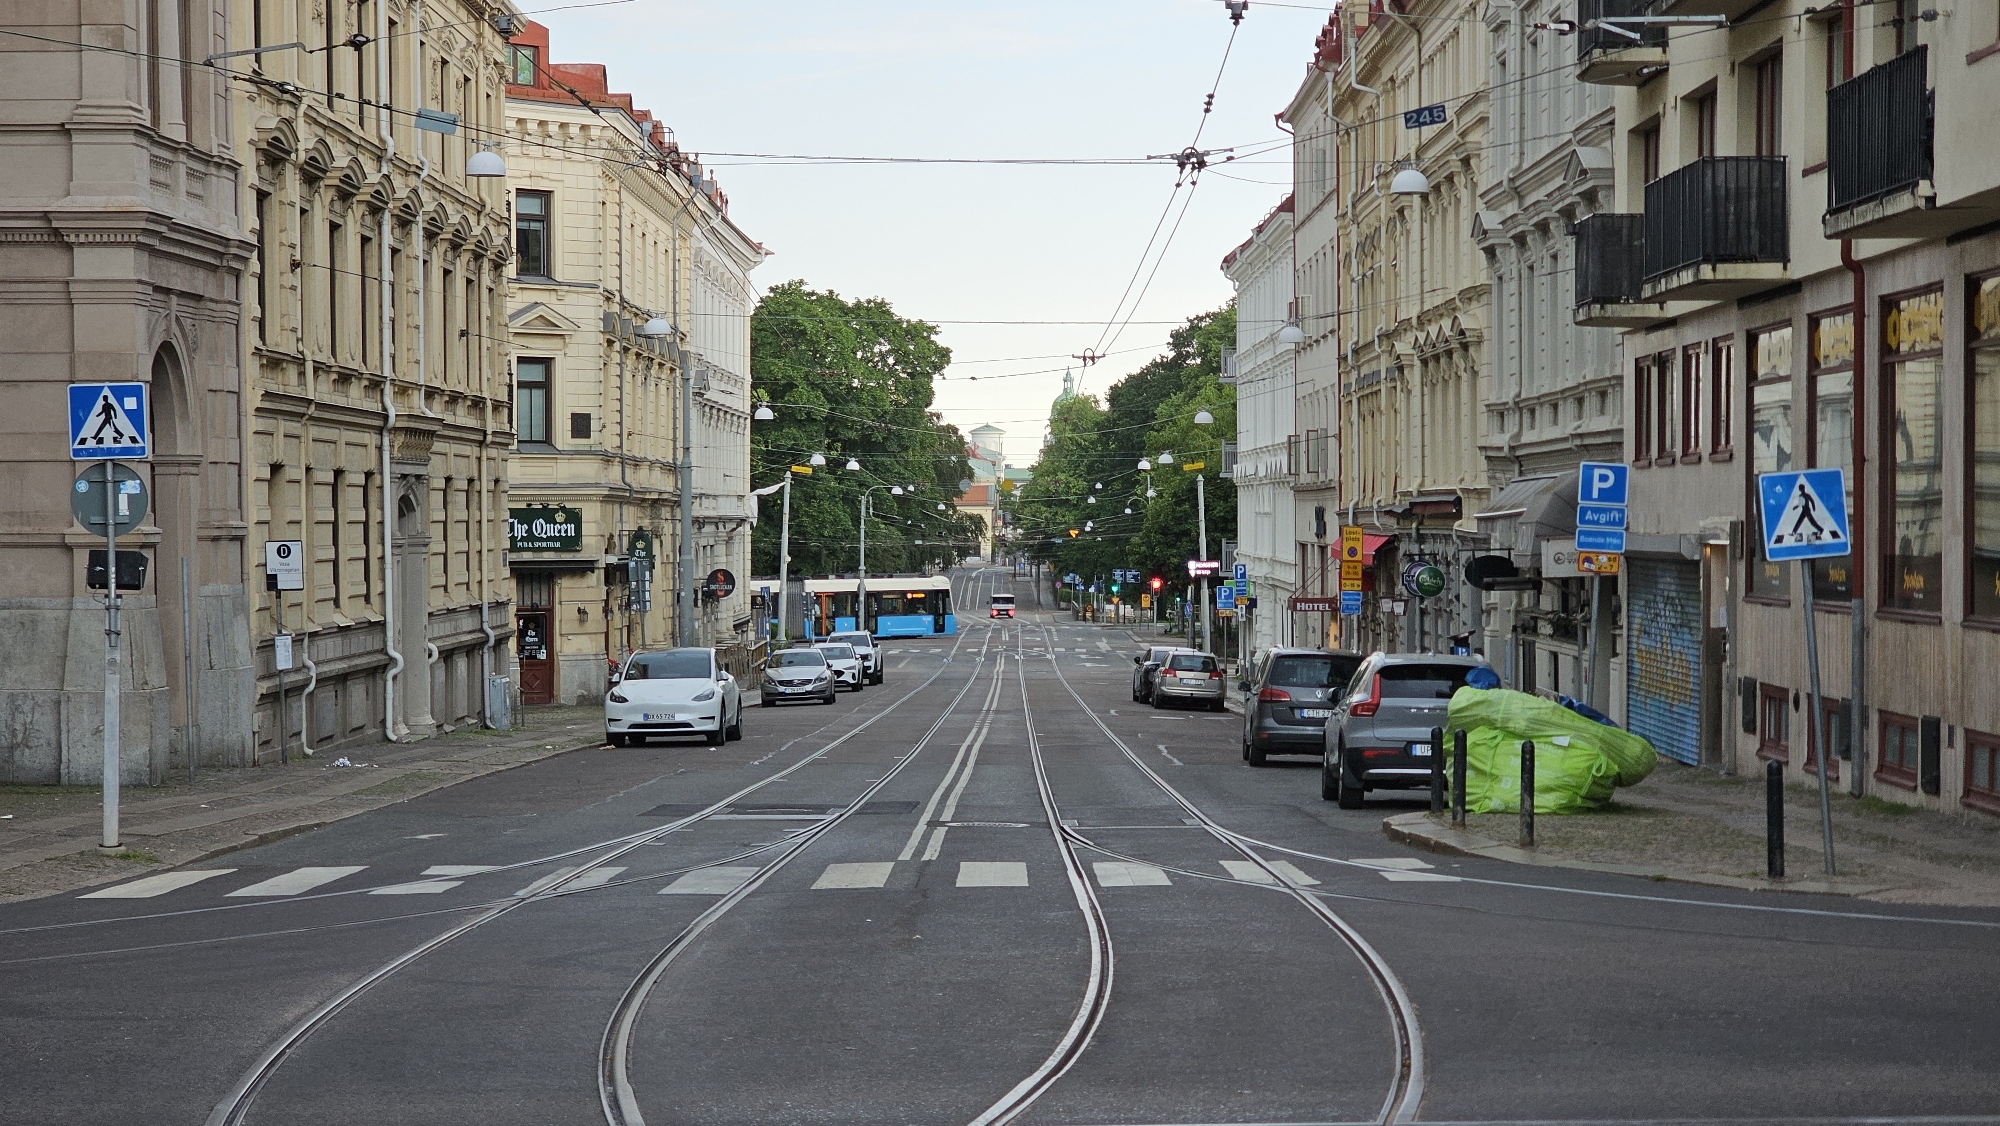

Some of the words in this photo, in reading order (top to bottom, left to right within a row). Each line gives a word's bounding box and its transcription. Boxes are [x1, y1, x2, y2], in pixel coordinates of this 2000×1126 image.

[1406, 107, 1445, 127] 245
[1592, 468, 1615, 498] P
[1585, 510, 1620, 524] Avgift
[508, 518, 528, 540] The
[532, 518, 576, 538] Queen
[280, 546, 288, 556] D
[634, 548, 646, 558] The
[1237, 565, 1245, 579] P
[1221, 587, 1230, 600] P
[1296, 602, 1331, 610] HOTEL
